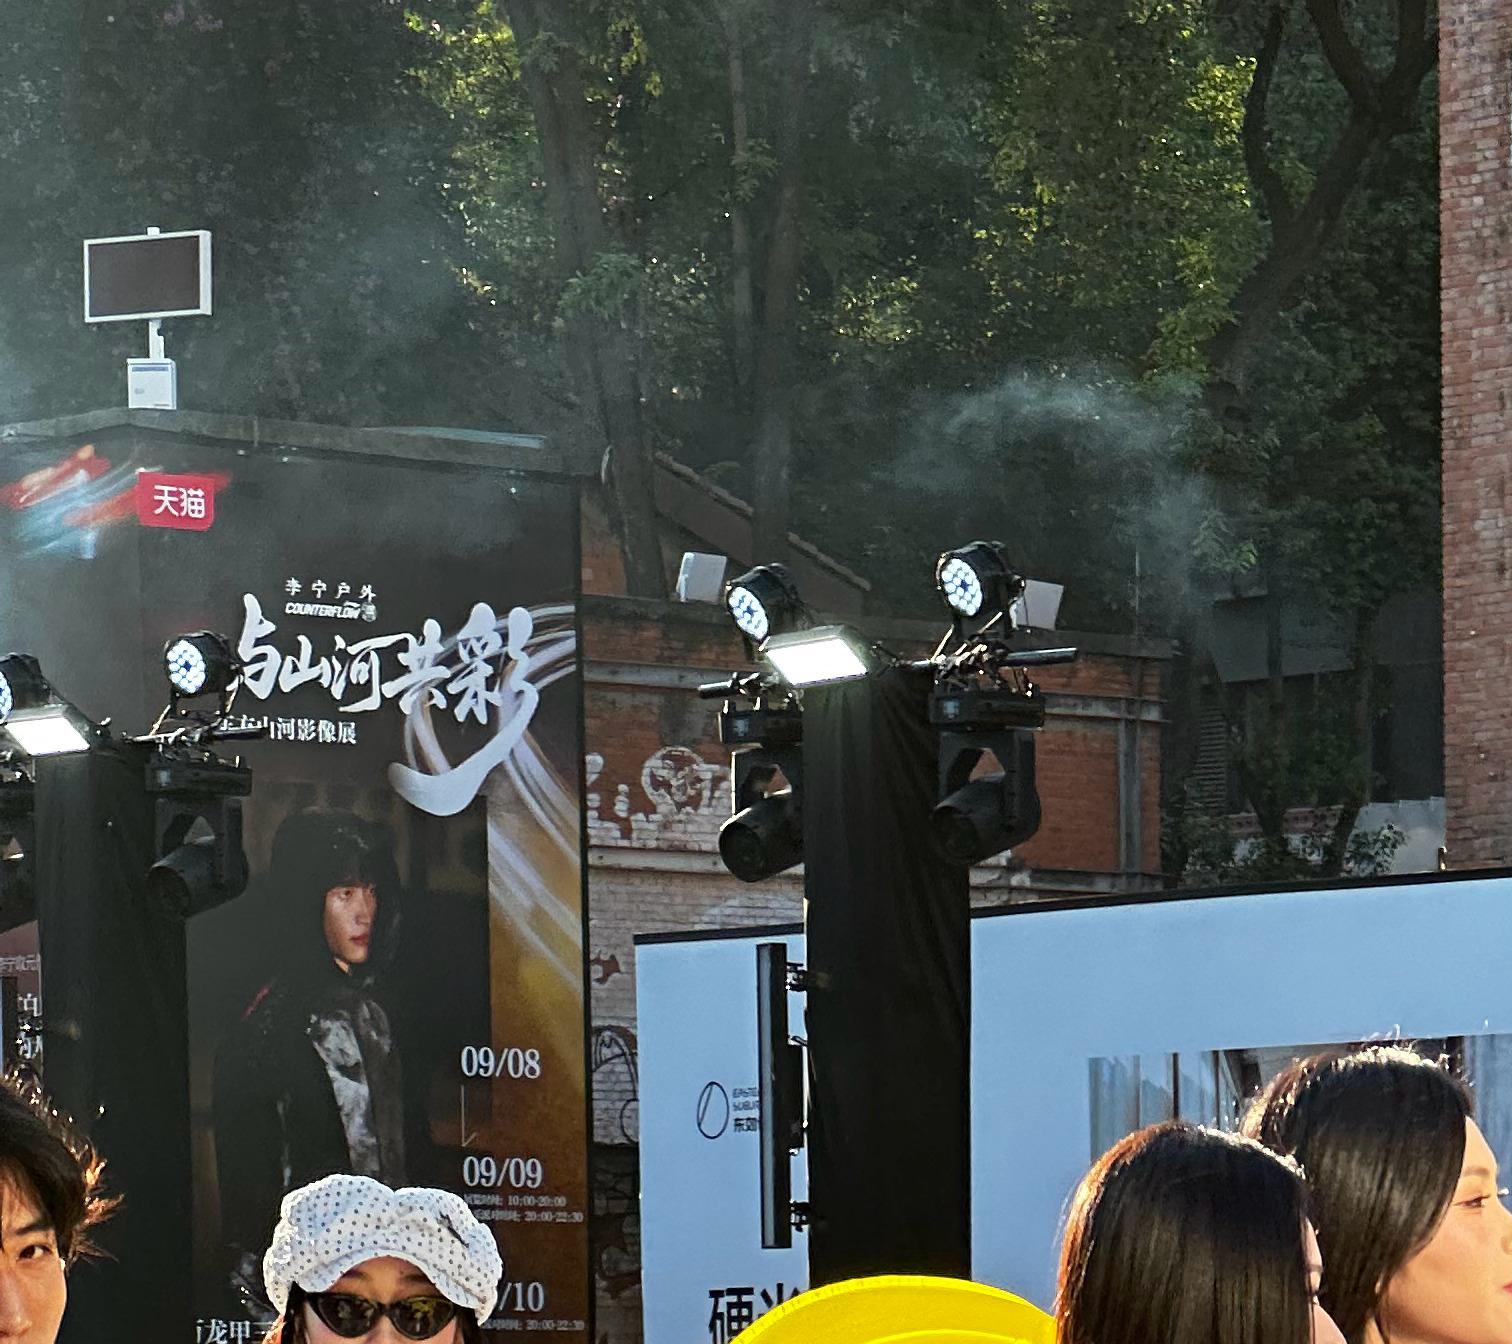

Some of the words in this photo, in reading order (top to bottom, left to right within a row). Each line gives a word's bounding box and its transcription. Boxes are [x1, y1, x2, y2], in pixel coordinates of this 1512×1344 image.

[153, 484, 206, 519] 天猫
[285, 576, 377, 600] 李宁户外
[460, 1045, 542, 1080] 09/08
[462, 1155, 544, 1189] 09/09
